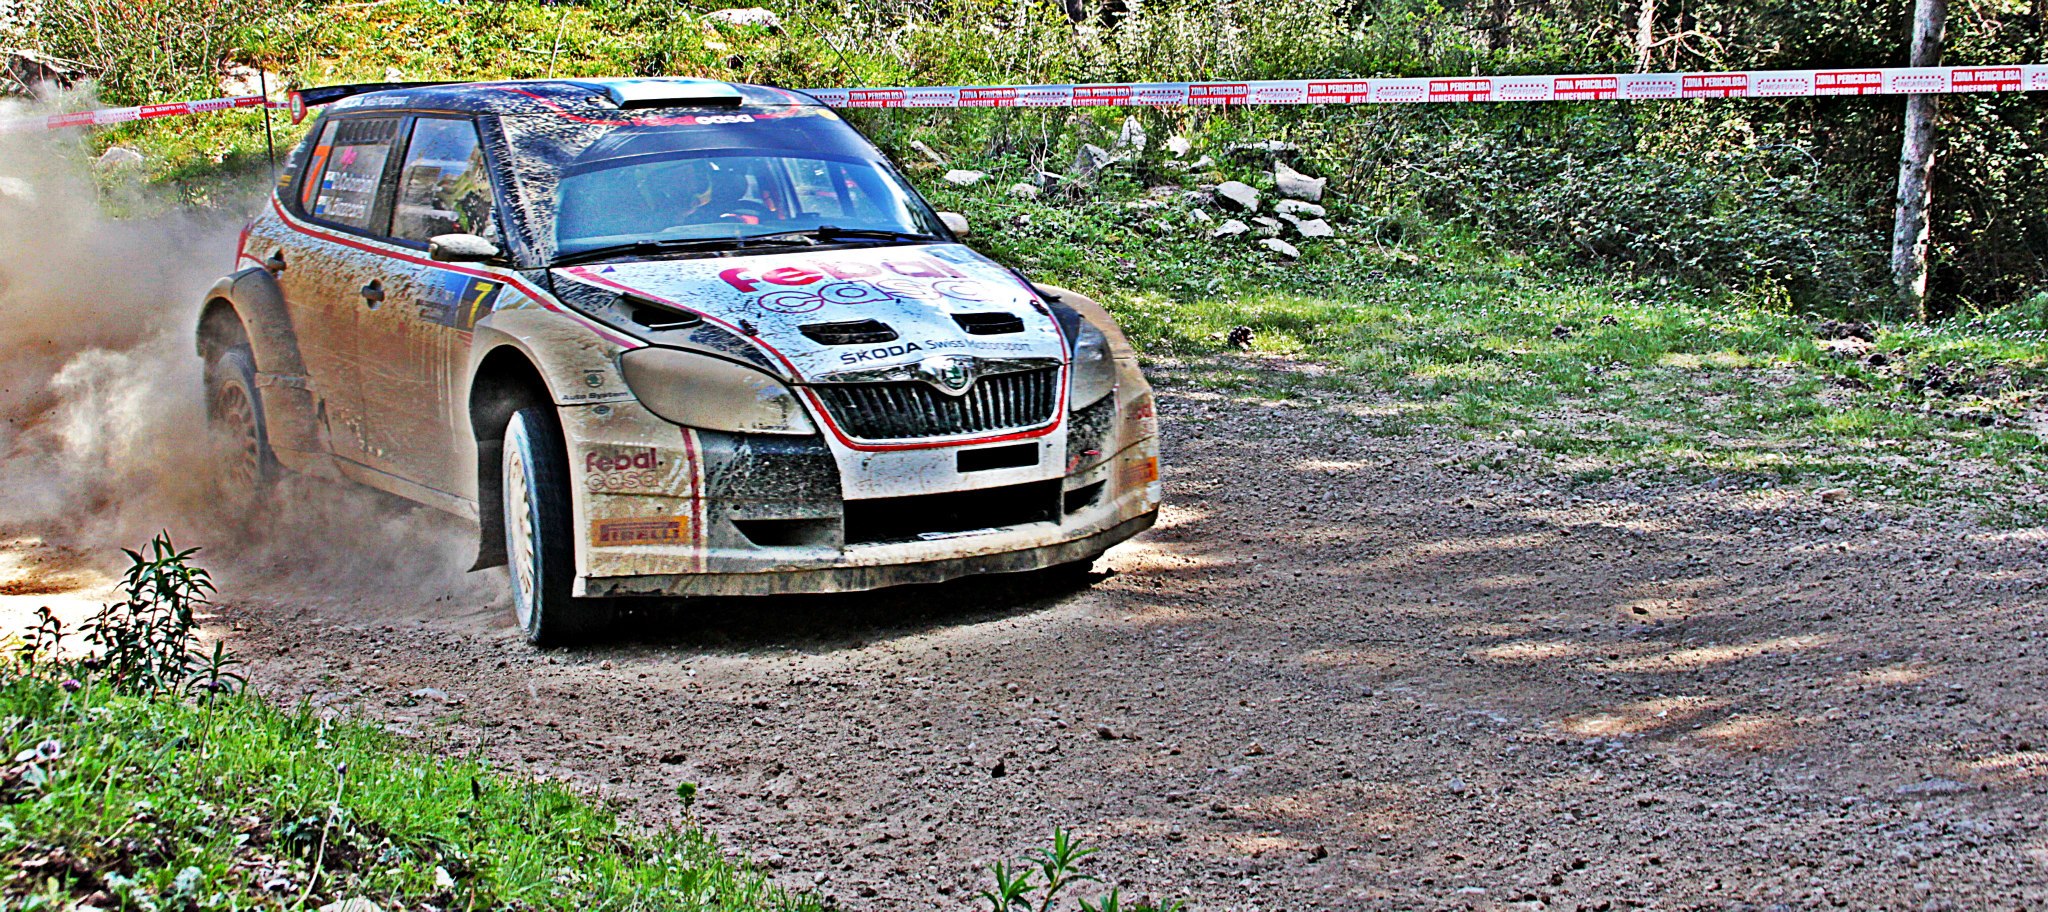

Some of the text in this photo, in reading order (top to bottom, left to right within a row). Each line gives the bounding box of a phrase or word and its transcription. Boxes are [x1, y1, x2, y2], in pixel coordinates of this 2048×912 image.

[1816, 74, 1880, 84] ZONA PERICOLOSA
[1954, 70, 2020, 81] ZONA PERICOLOSA
[1431, 82, 1490, 91] ZONA PERICOLOSA
[1556, 80, 1616, 89] ZONA PERICOLOSA
[1684, 77, 1746, 87] ZONA PERICOLOSA
[1074, 88, 1129, 97] ZONA PERICOLOSA
[1190, 85, 1247, 95] ZONA PERICOLOSA
[1309, 84, 1367, 94] ZONA PERICOLOSA
[303, 146, 330, 202] 7
[719, 257, 968, 292] febal
[468, 282, 494, 328] 7
[926, 339, 1033, 351] Swiss Motorsport
[840, 342, 922, 365] ŠKODA
[586, 448, 656, 472] febal
[587, 470, 659, 491] casa
